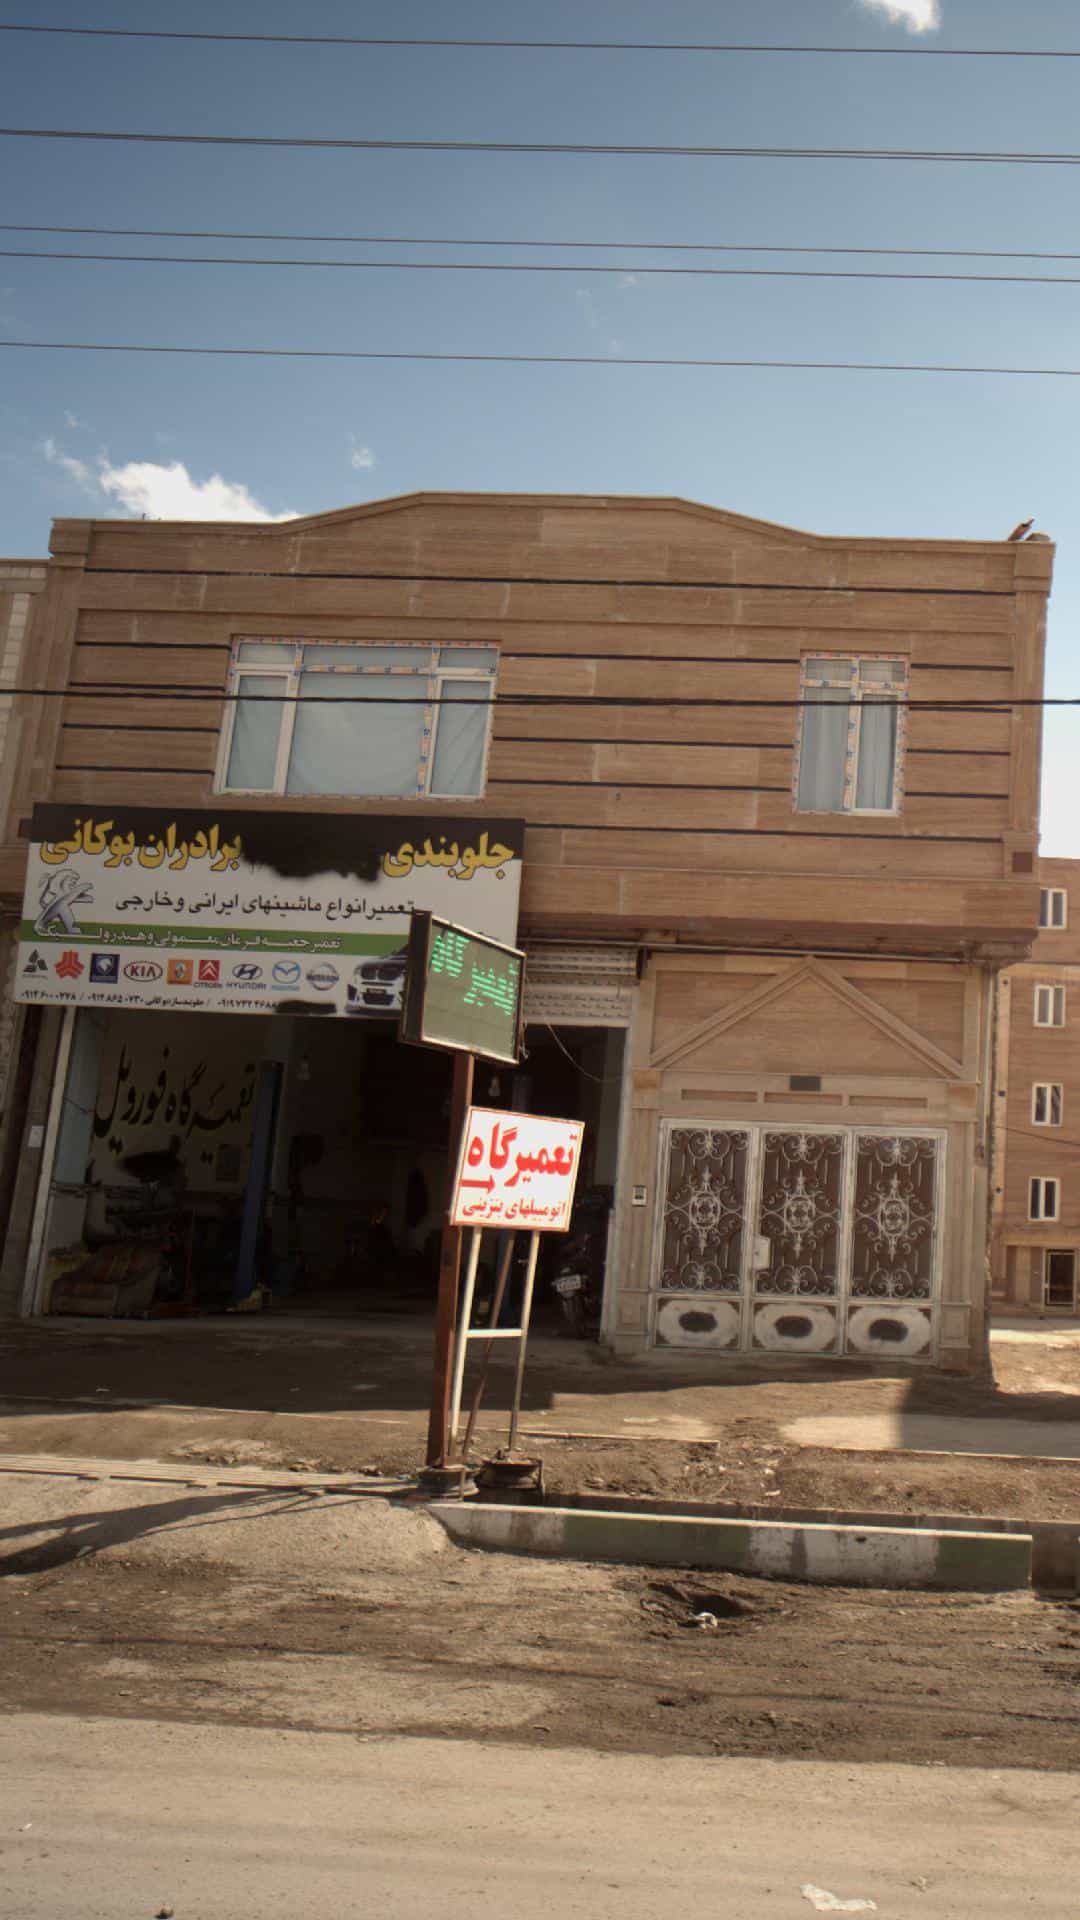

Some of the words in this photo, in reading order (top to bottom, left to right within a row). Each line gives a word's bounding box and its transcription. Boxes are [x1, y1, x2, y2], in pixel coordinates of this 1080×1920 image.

[40, 818, 135, 868] بوکانی
[137, 822, 241, 872] برادران
[383, 831, 515, 881] جلوبندی
[189, 892, 239, 916] ایرانی
[242, 895, 322, 917] ماشینهای
[130, 962, 157, 977] KIA
[467, 1121, 577, 1187] تعمیرگاه
[462, 1197, 504, 1218] بنزینی
